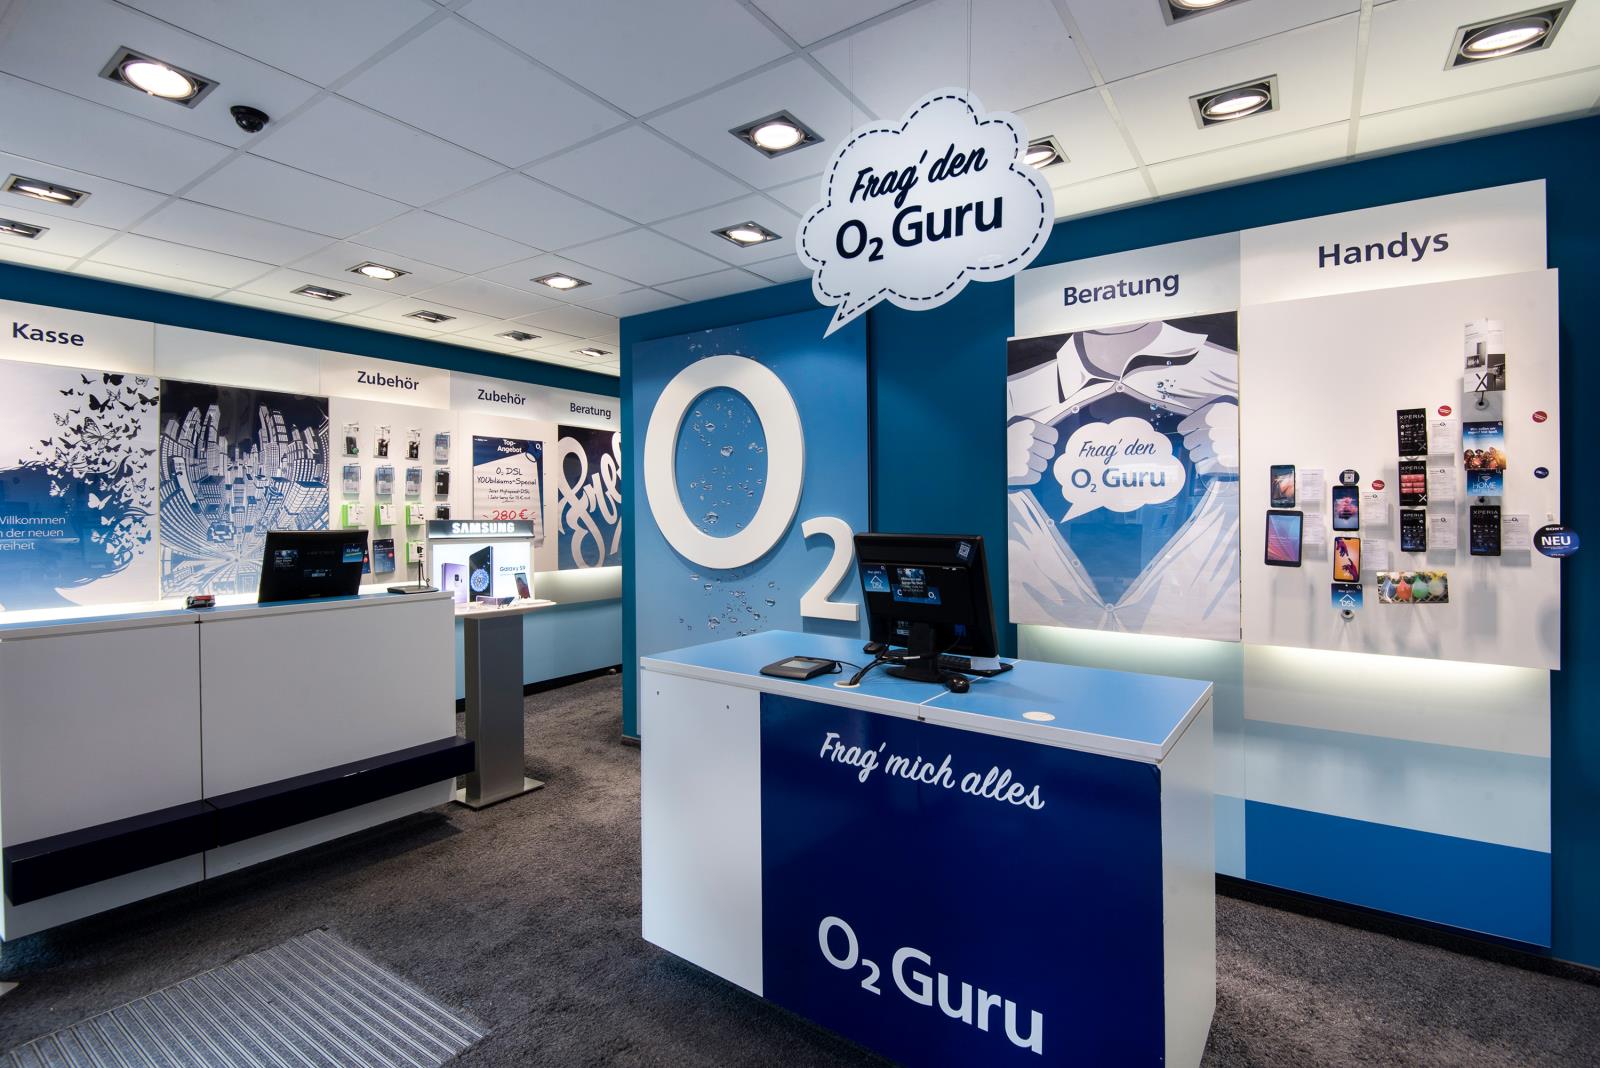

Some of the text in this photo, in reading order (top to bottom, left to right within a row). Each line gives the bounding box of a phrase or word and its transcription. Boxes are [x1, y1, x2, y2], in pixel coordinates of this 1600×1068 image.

[928, 143, 988, 183] den
[892, 196, 1003, 248] Guru
[1318, 232, 1450, 268] Handys
[1064, 272, 1180, 306] Beratung
[12, 322, 84, 347] Kasse
[357, 370, 420, 391] Zubehör
[477, 388, 526, 406] Zubehör
[570, 402, 612, 420] Beratung
[1124, 438, 1156, 456] den
[506, 467, 523, 476] DSL
[1101, 466, 1166, 490] Guru
[492, 509, 528, 520] 280 €
[6, 528, 25, 538] der
[28, 529, 64, 537] neuen
[452, 522, 515, 534] SAMSUNG
[1541, 535, 1571, 546] NEU
[884, 754, 955, 789] mich
[960, 766, 1045, 810] alles
[891, 946, 1043, 1056] Guru
